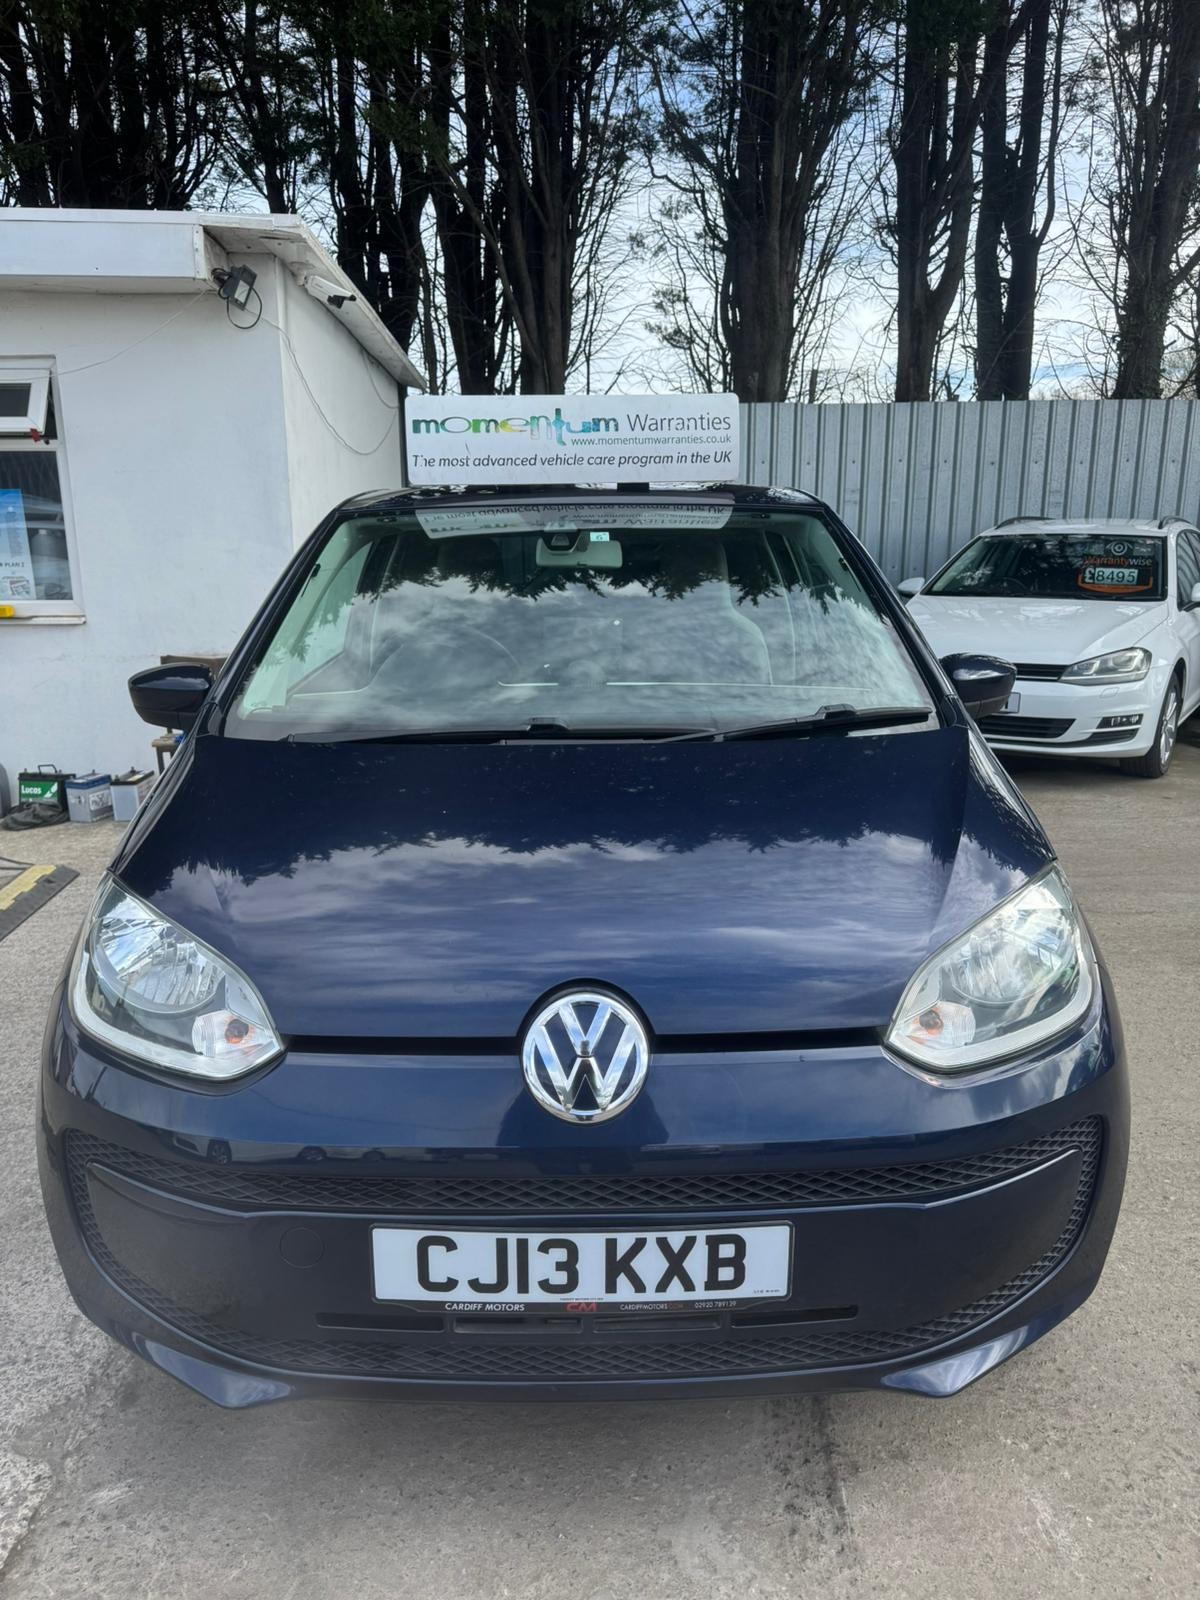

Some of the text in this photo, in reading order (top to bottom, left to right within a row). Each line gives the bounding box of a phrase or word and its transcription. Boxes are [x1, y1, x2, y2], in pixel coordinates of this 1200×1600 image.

[412, 408, 731, 446] momentum Warranties
[570, 434, 731, 446] www.momentumwarranties.co.uk
[438, 455, 470, 467] most
[473, 454, 537, 467] advanced
[540, 453, 584, 466] vehicle
[587, 455, 615, 466] care
[617, 455, 674, 468] program
[676, 452, 687, 464] in
[690, 451, 711, 464] the
[714, 450, 732, 463] UK
[1084, 567, 1136, 583] £8495
[21, 785, 42, 794] Lucas
[416, 1233, 747, 1295] CJ13 KXB
[444, 1302, 525, 1312] CARDIFF MOTORS
